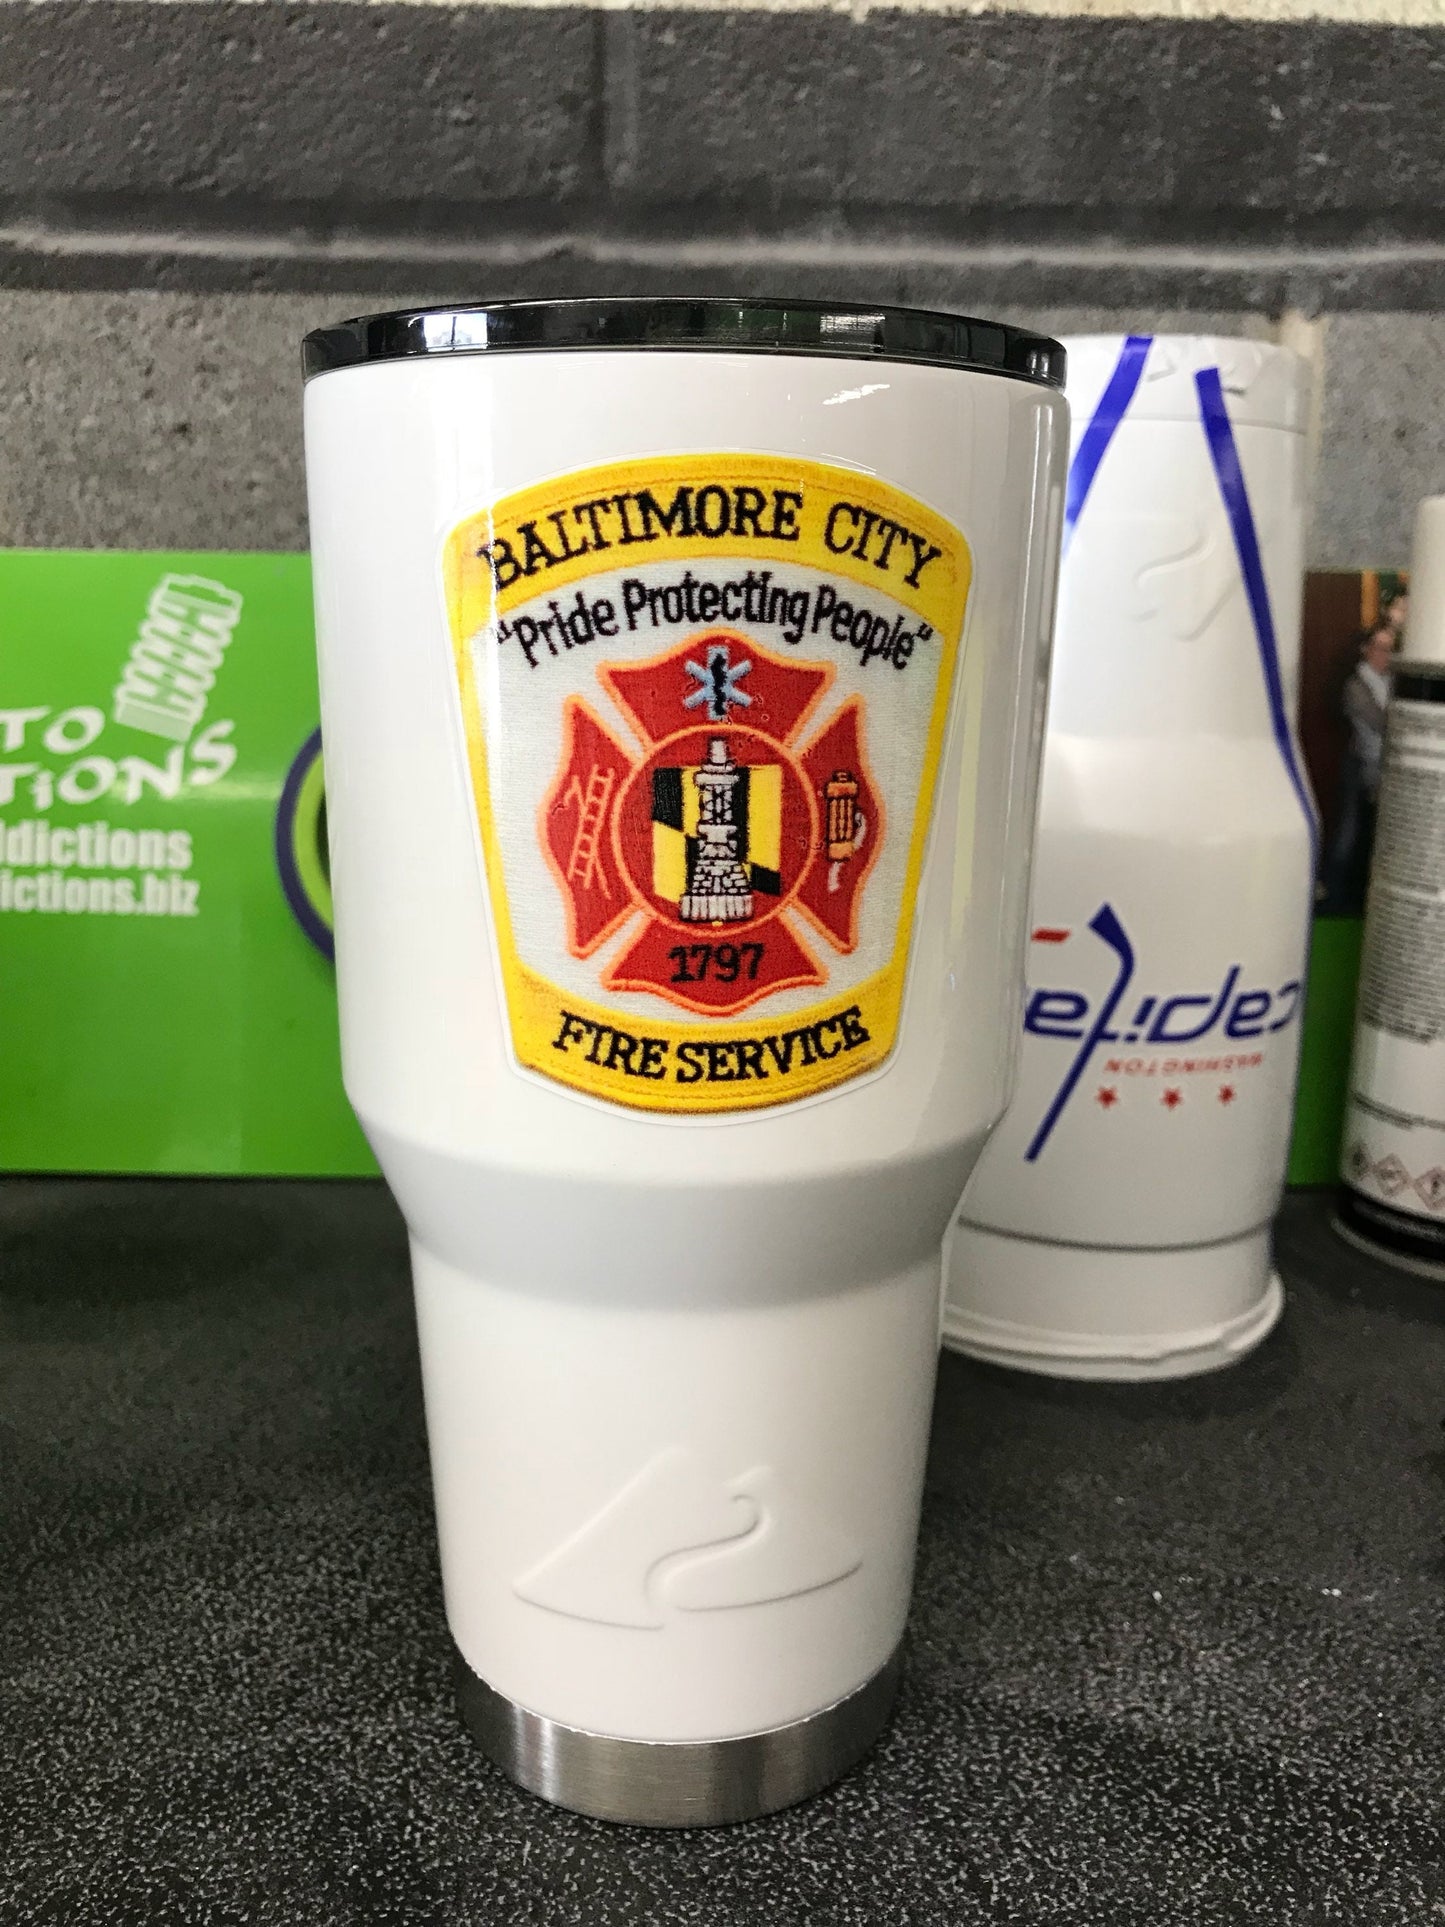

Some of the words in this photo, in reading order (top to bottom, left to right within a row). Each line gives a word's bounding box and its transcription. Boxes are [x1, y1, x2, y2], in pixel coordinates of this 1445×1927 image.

[477, 484, 804, 592] BALTIMORE
[824, 501, 943, 588] CITY
[622, 570, 810, 645] Protecting
[0, 818, 192, 871] dictions
[668, 942, 765, 984] 1797
[552, 1009, 669, 1082] FIRE
[676, 1005, 871, 1083] SERVICE
